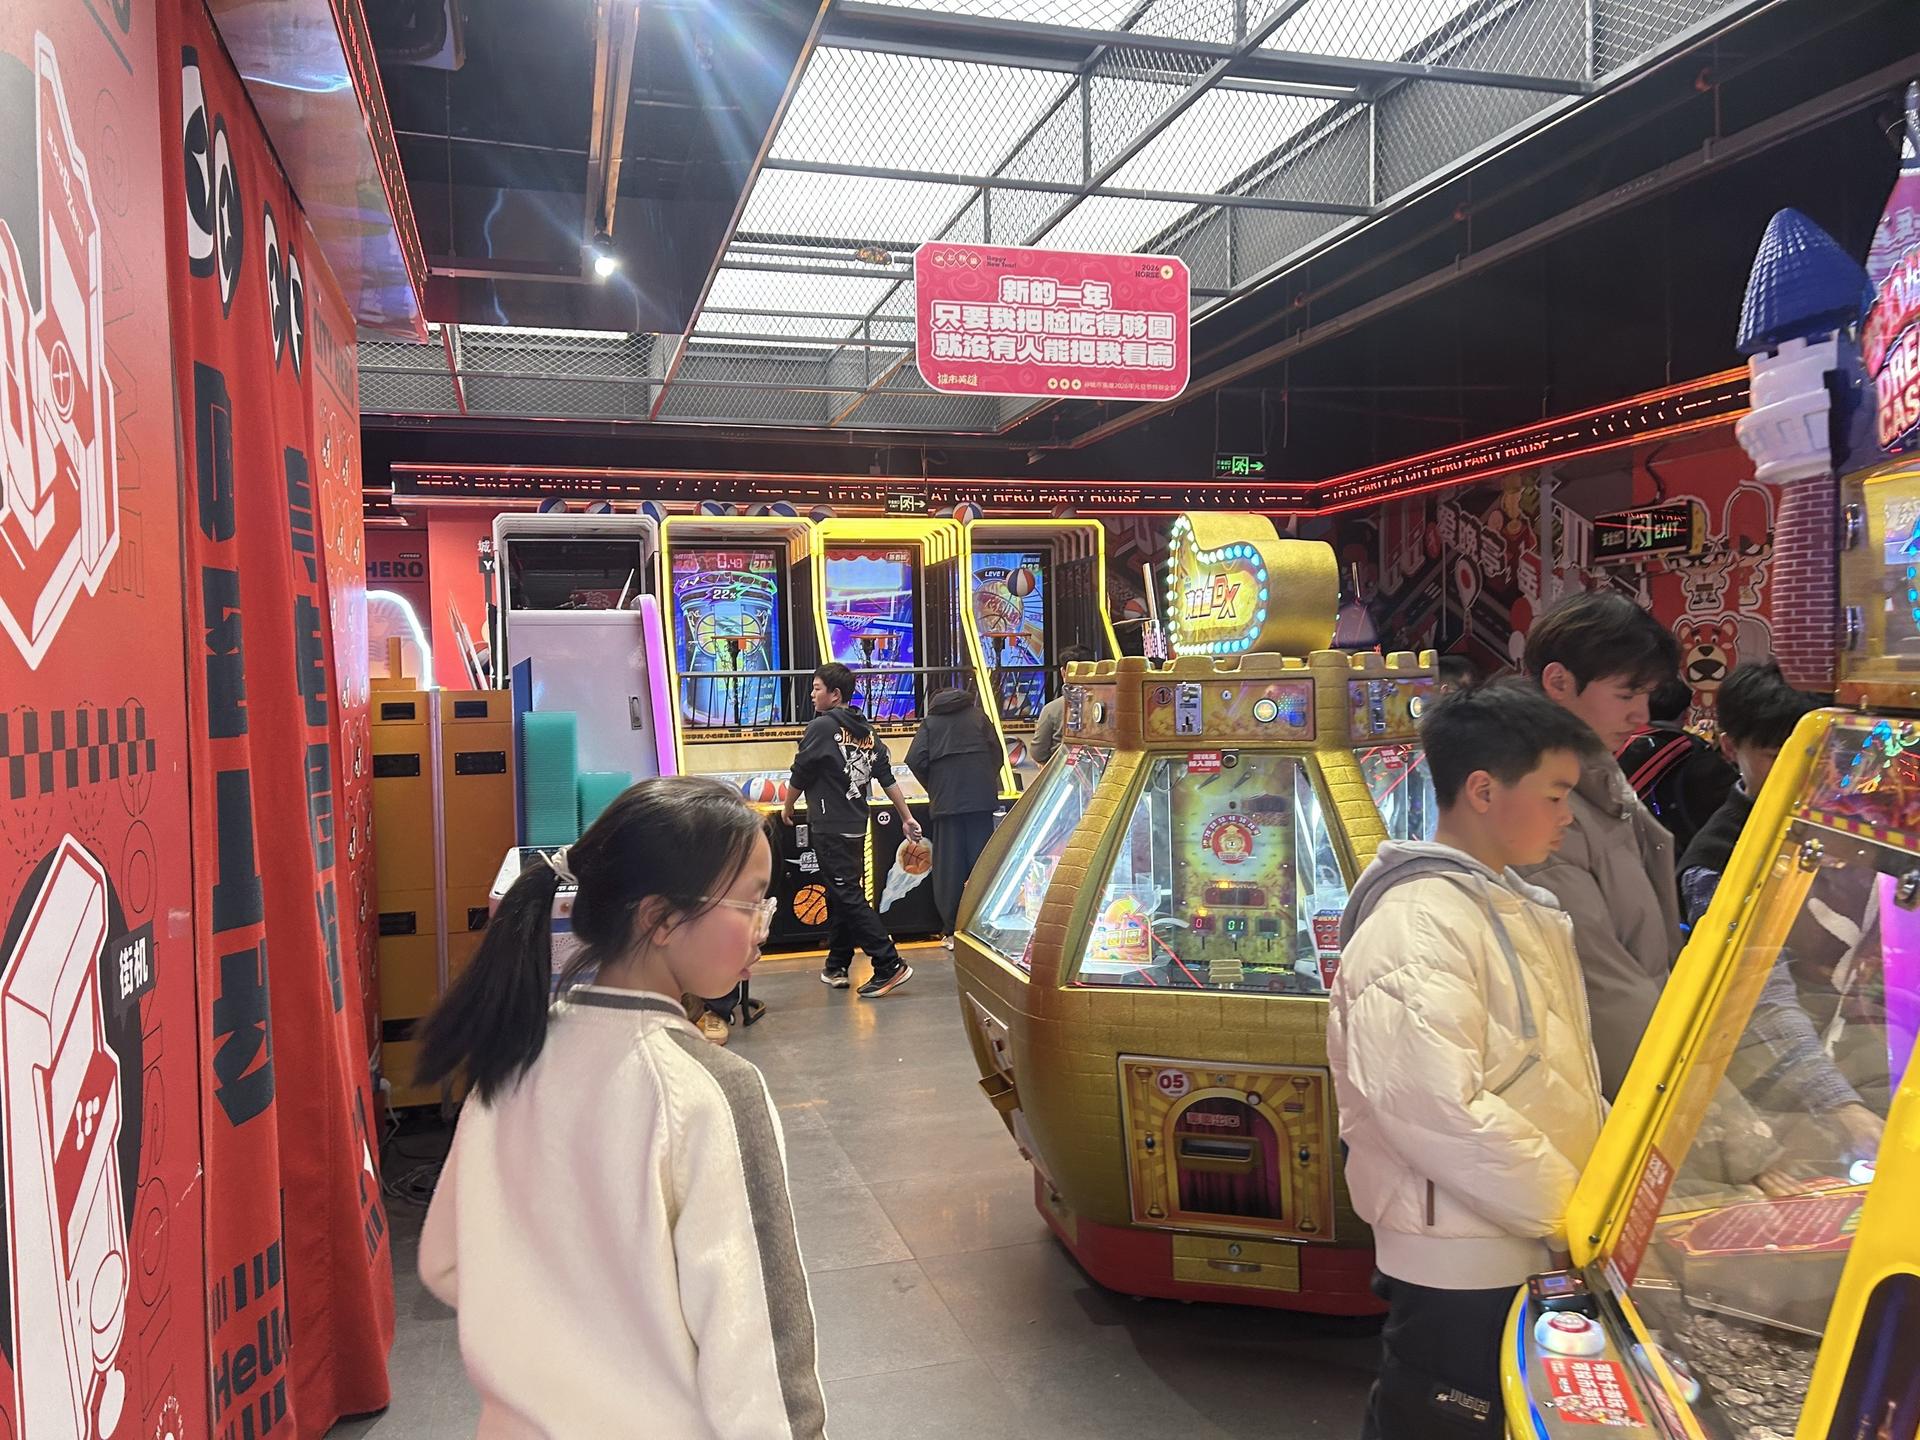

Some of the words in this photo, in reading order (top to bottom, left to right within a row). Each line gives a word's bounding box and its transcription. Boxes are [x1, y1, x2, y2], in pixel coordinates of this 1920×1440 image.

[1135, 271, 1160, 279] HORSE
[1001, 277, 1109, 308] 新的一年
[934, 304, 1173, 341] 只要我把脸吃得够圆
[934, 332, 1174, 368] 就没有人能把我看扁
[1654, 521, 1679, 540] EXIT
[713, 589, 737, 600] 22%
[119, 936, 149, 999] 街机
[1159, 1074, 1185, 1090] 05
[1571, 1362, 1604, 1409] 可投币游玩
